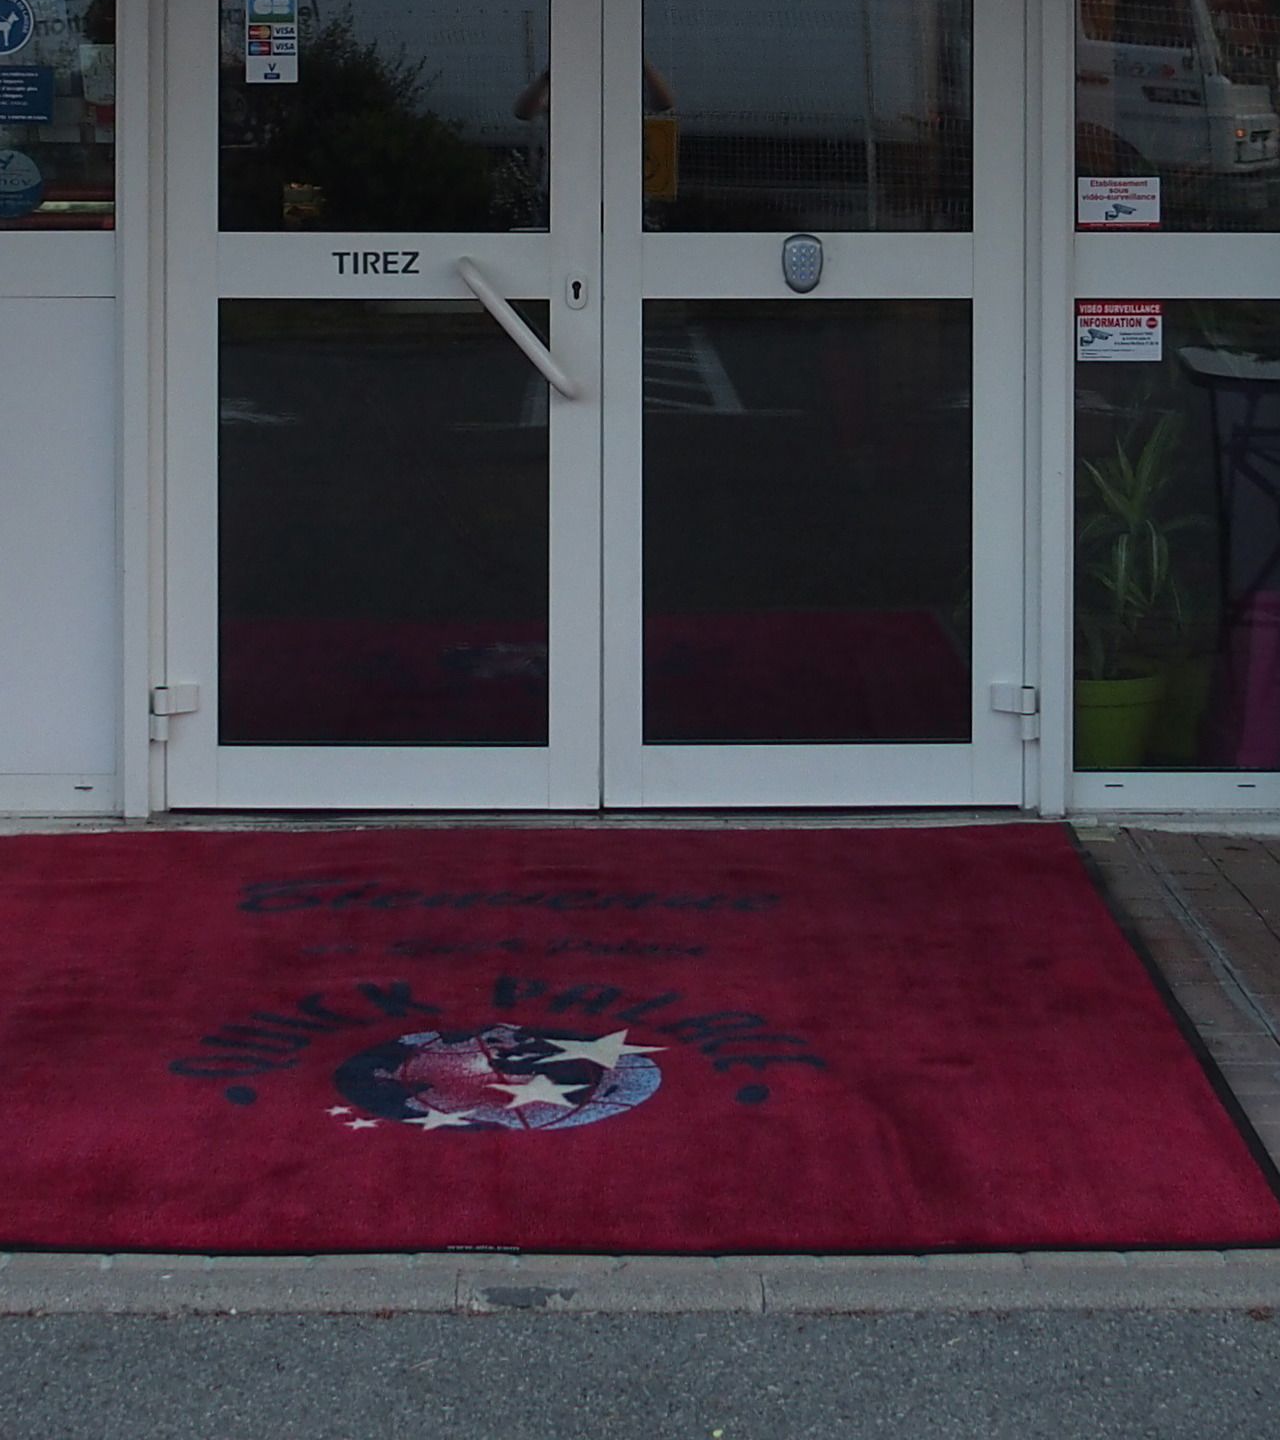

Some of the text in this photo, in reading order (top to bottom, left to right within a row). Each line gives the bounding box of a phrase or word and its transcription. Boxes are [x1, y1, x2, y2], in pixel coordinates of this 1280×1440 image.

[275, 27, 295, 35] VISA
[275, 43, 295, 51] VISA
[1090, 180, 1148, 188] Etablissement
[332, 252, 421, 275] TIREZ
[1080, 304, 1161, 314] VIDEO SURVEILLANCE
[1080, 318, 1142, 328] INFORMATION
[166, 973, 828, 1077] QUICK PALACE
